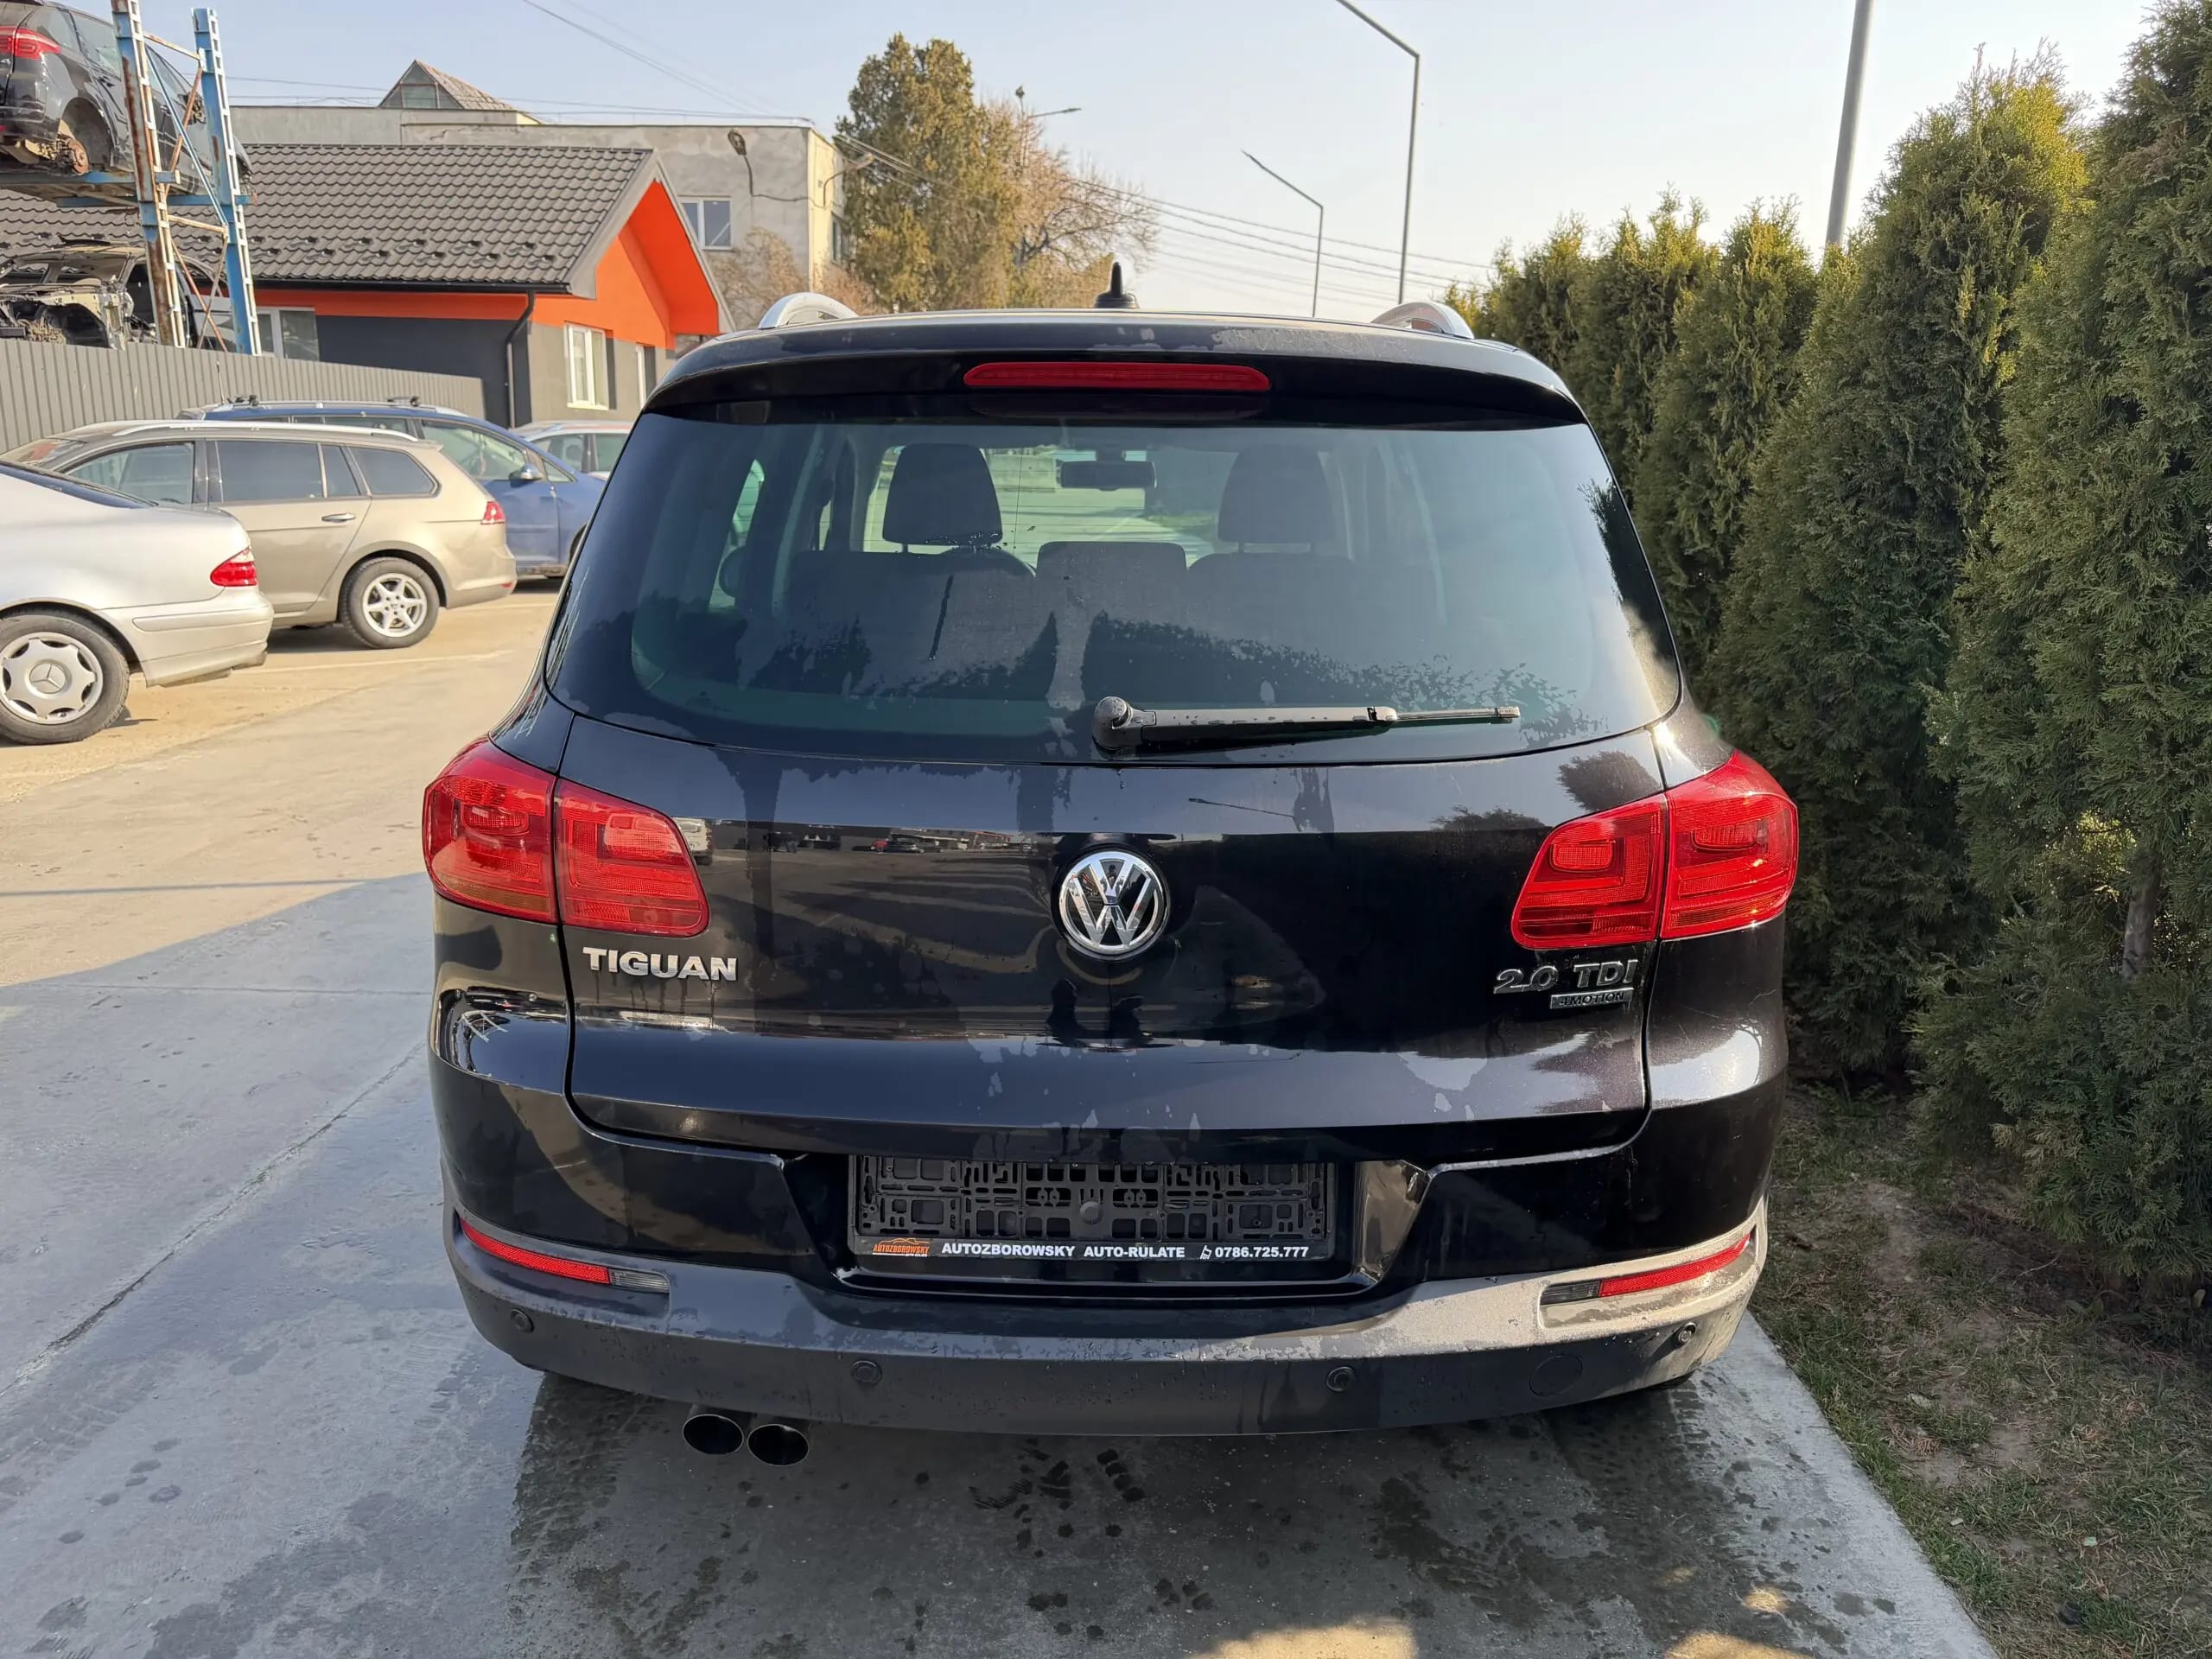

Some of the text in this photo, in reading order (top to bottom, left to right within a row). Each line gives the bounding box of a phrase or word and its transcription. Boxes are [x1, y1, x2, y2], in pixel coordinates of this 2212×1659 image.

[582, 946, 737, 982] TIGUAN
[1493, 958, 1639, 995] 2.0 TDI
[1559, 992, 1625, 1007] 4MOTION
[941, 1243, 1309, 1258] AUTOZBOROWSKY AUTO-RULATE 0786.725.777
